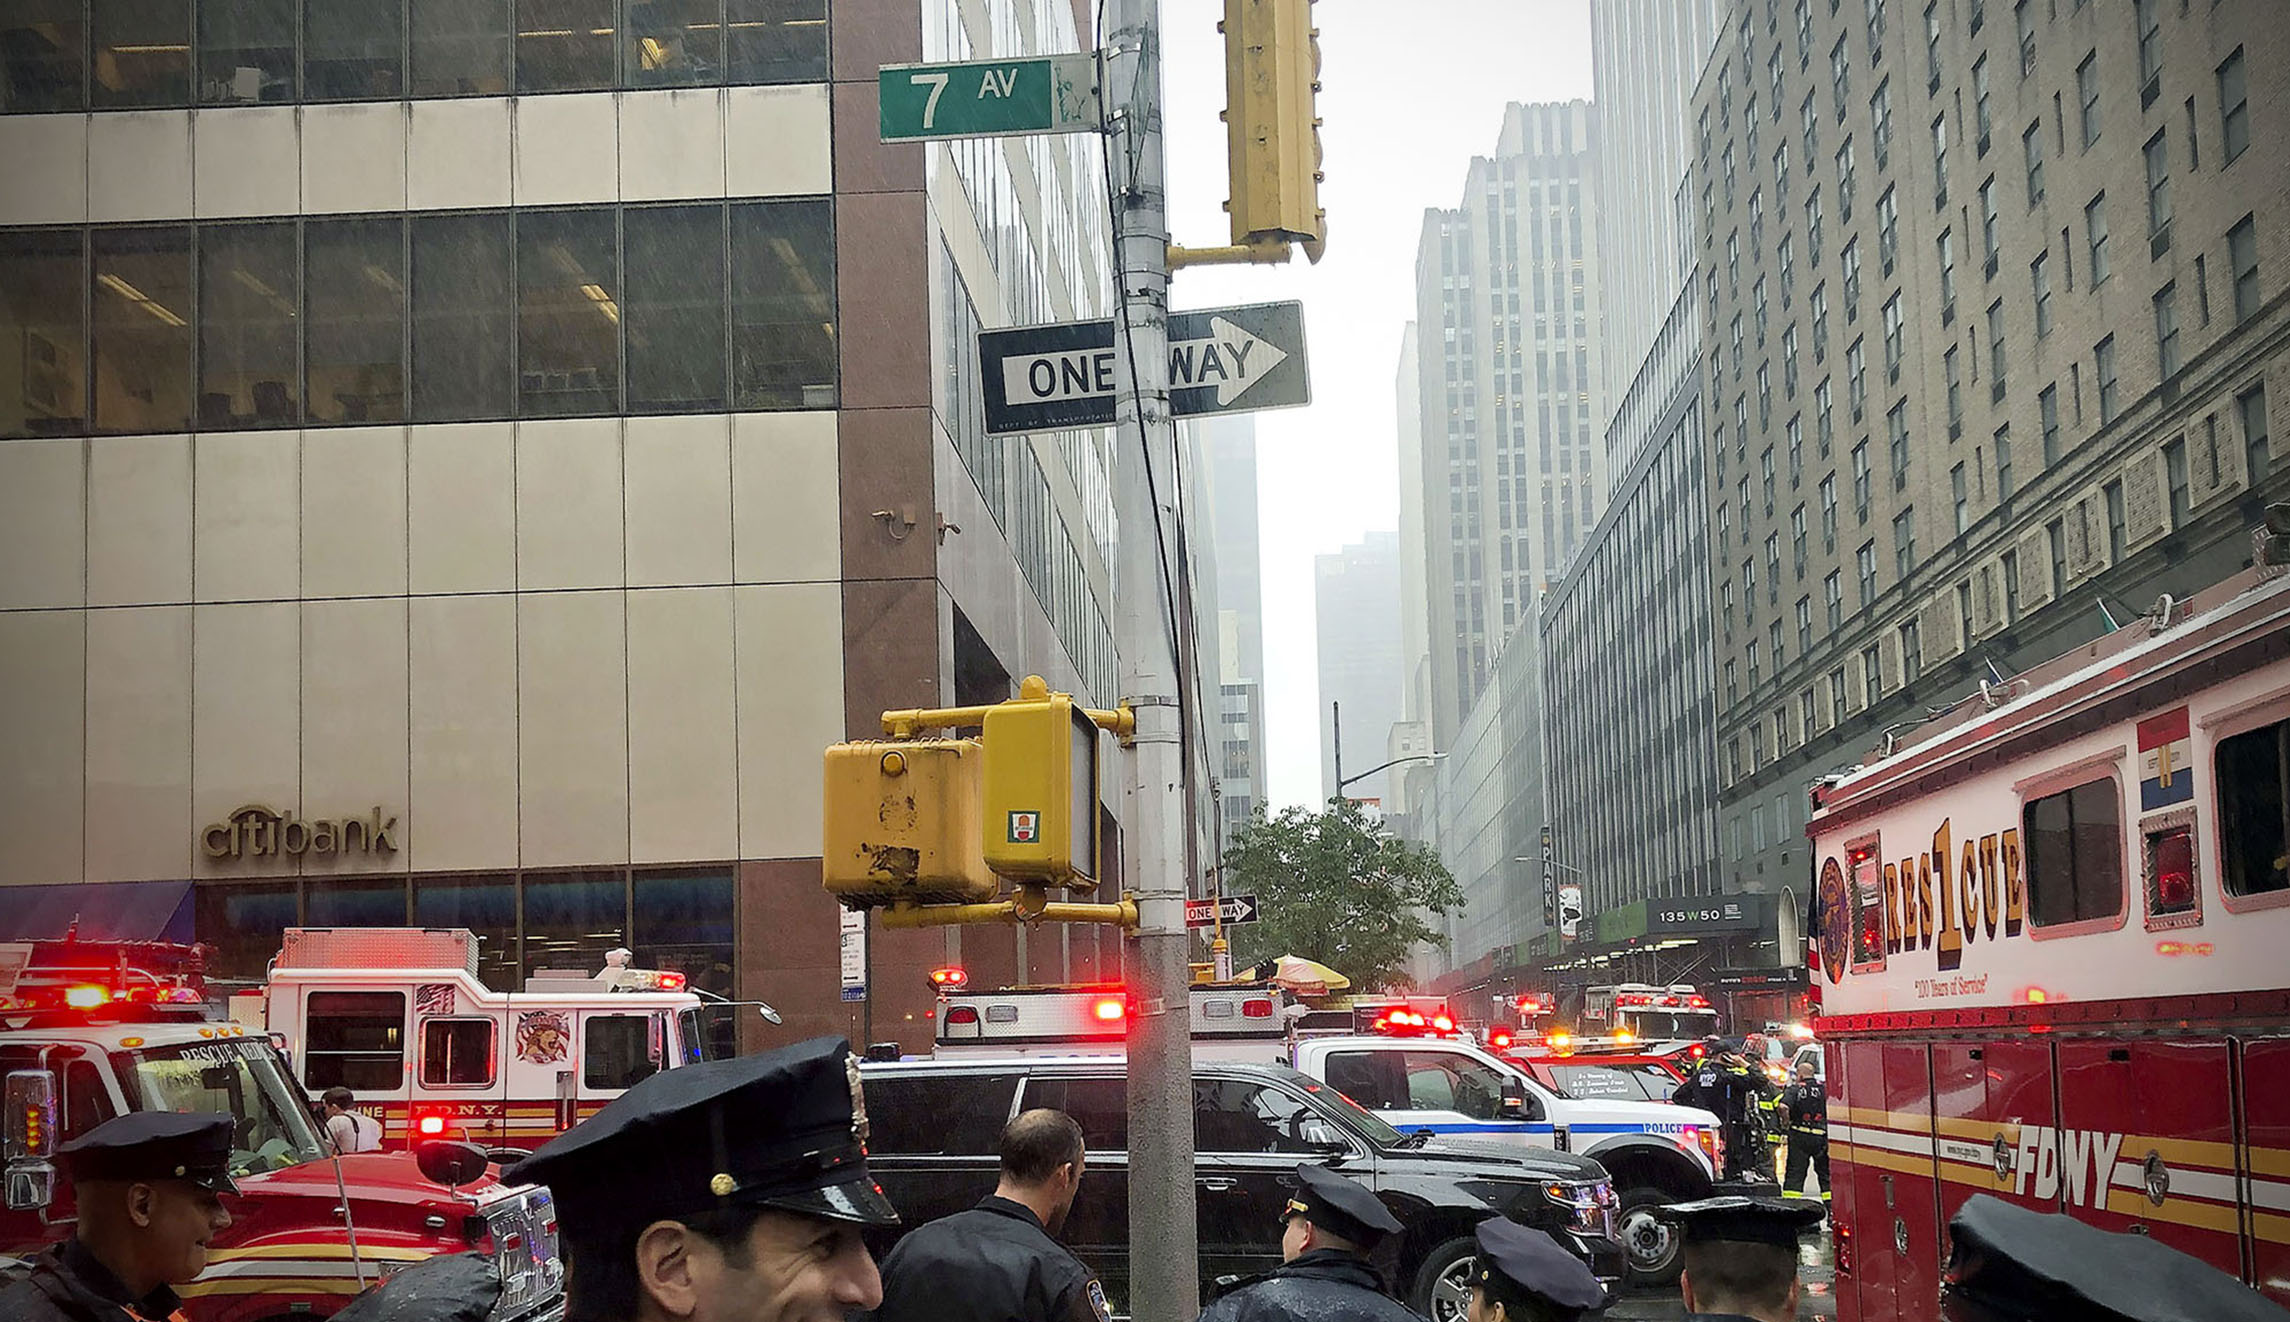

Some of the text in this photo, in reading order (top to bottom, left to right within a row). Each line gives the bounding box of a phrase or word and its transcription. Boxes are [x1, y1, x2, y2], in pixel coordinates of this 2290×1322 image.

[910, 68, 1018, 129] 7 AV
[1028, 339, 1254, 398] ONE WAY
[200, 804, 399, 858] citibank
[1542, 846, 1553, 908] PARK
[1188, 904, 1245, 919] ONE WAY
[179, 1043, 238, 1063] RESCUE
[1643, 1123, 1683, 1134] POLICE
[2015, 1125, 2122, 1211] FDNY
